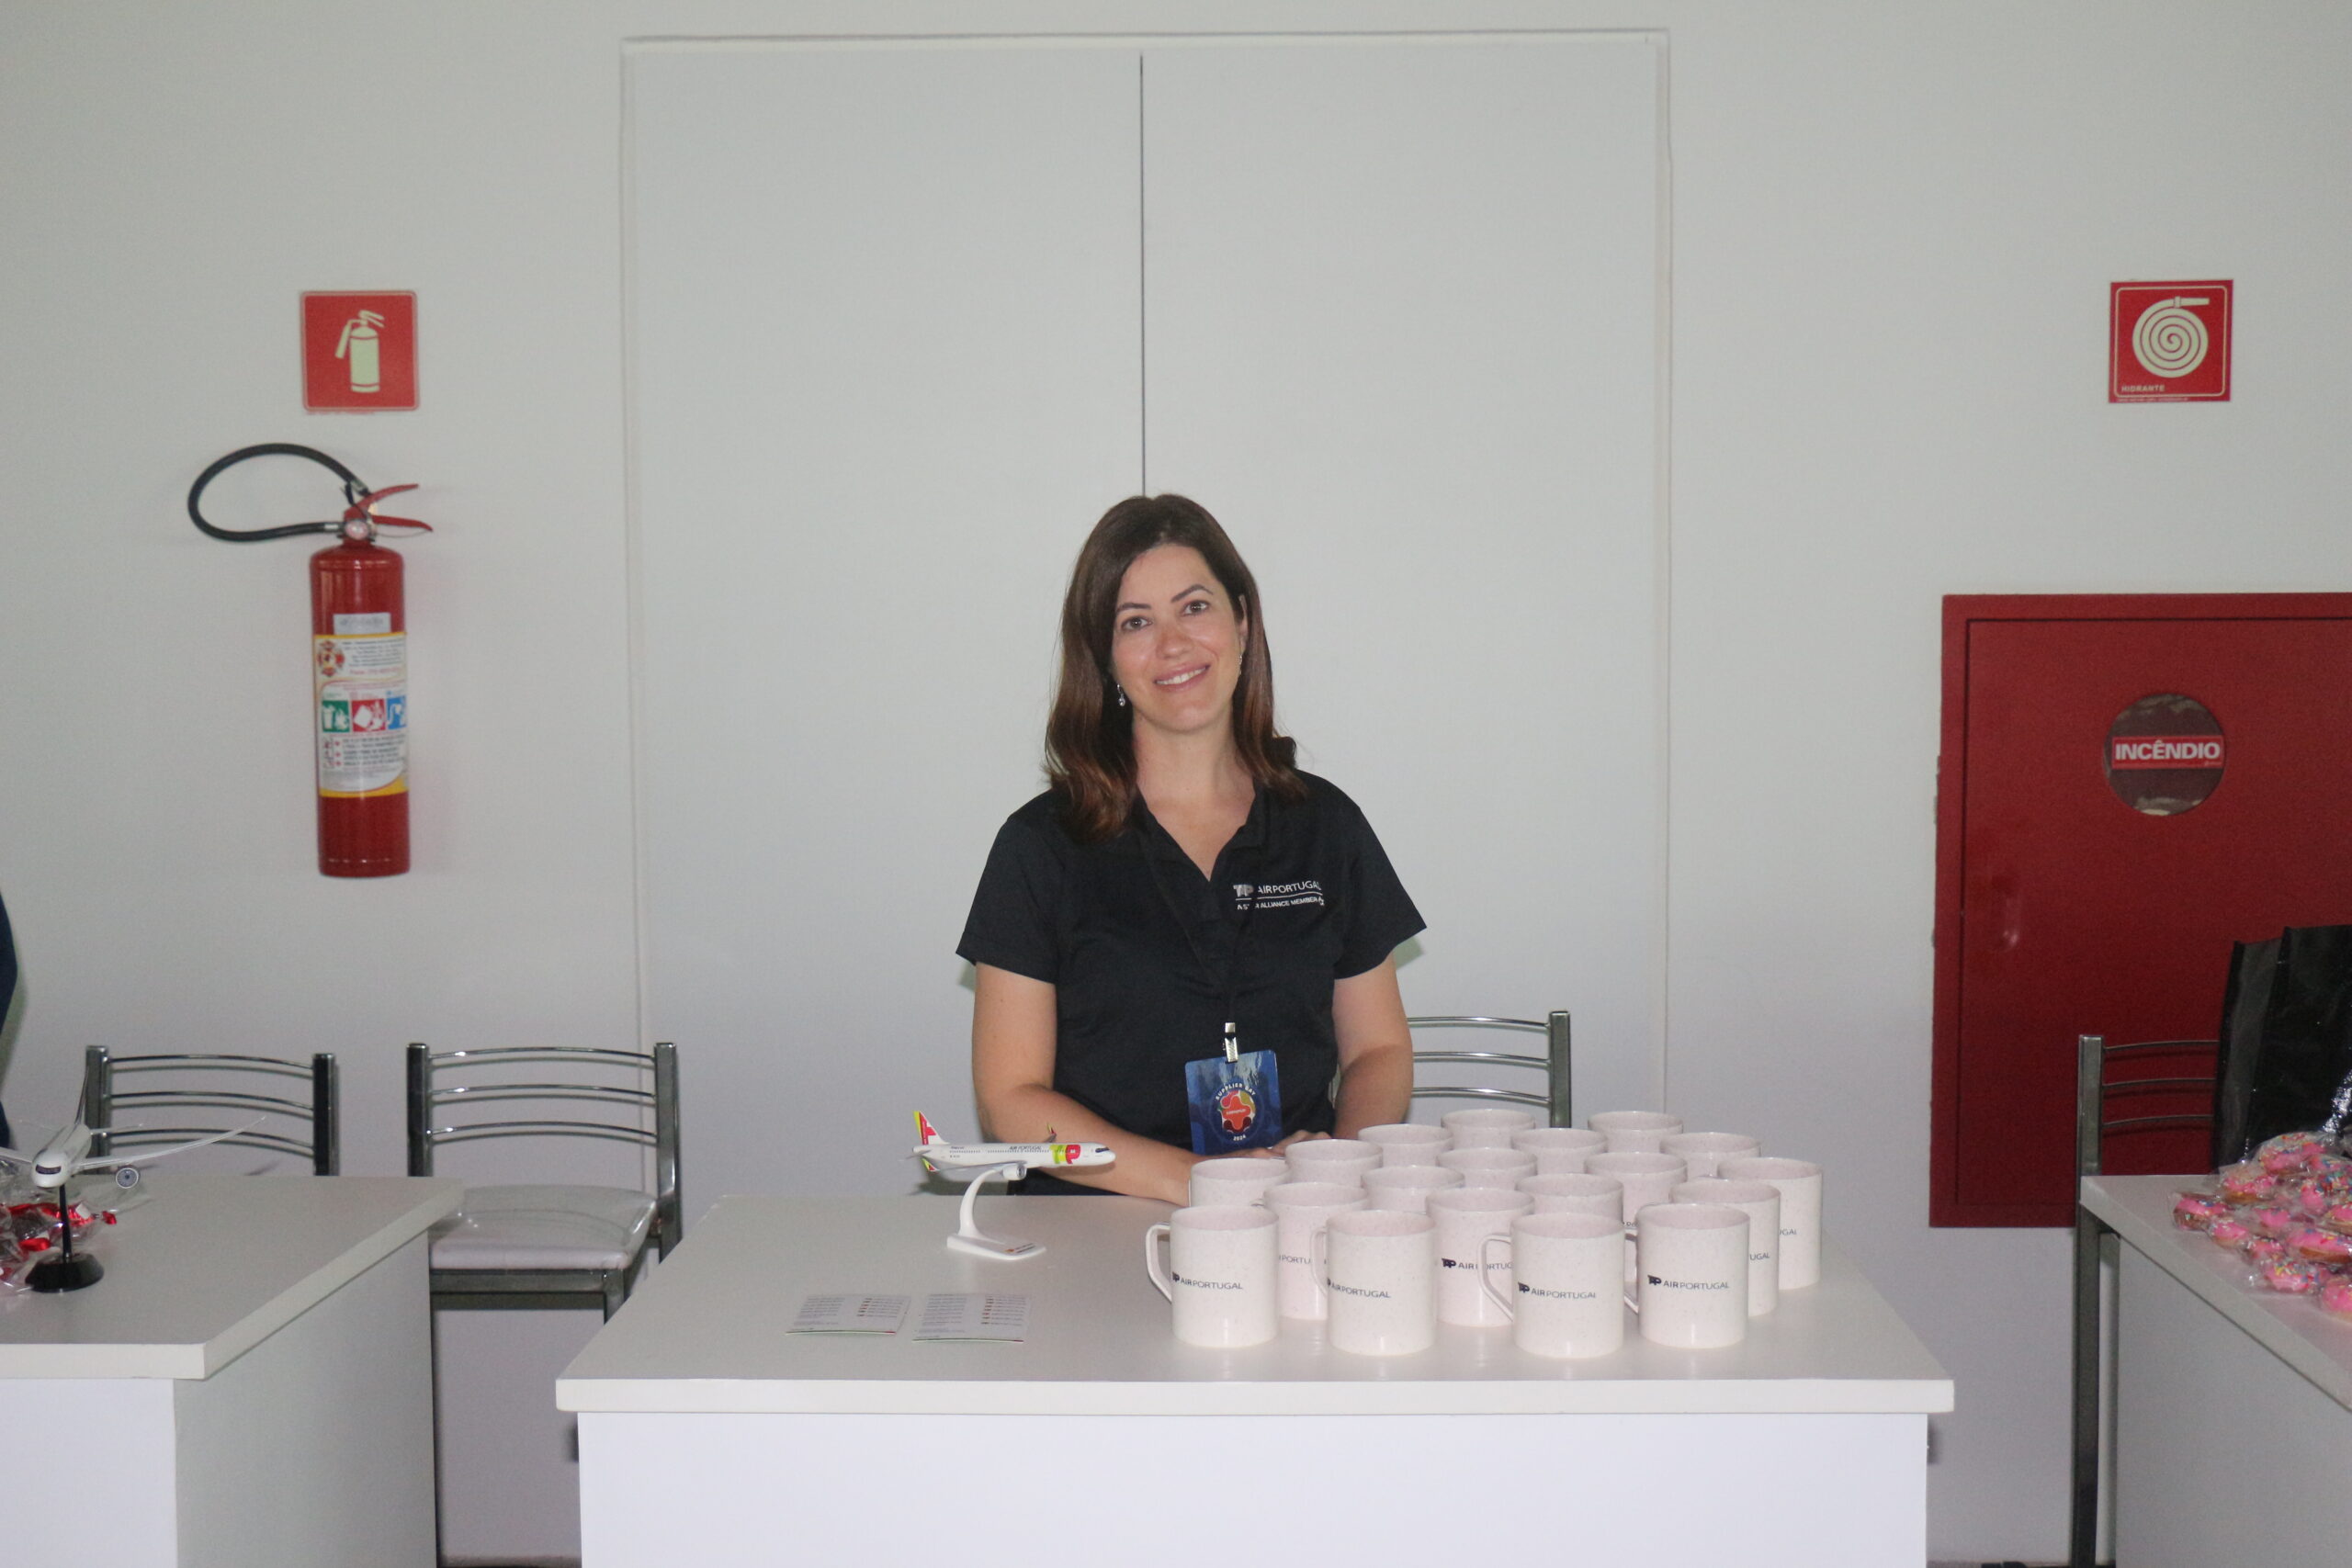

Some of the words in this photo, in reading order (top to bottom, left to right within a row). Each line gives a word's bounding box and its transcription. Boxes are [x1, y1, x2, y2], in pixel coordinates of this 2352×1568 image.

[2121, 384, 2165, 392] HIDRANTE
[2115, 739, 2221, 760] INCÊNDIO
[1261, 899, 1291, 908] ALLIANCE
[1291, 897, 1318, 906] MEMBER
[1216, 1083, 1243, 1100] SUPPLIER
[1244, 1086, 1256, 1096] DAY
